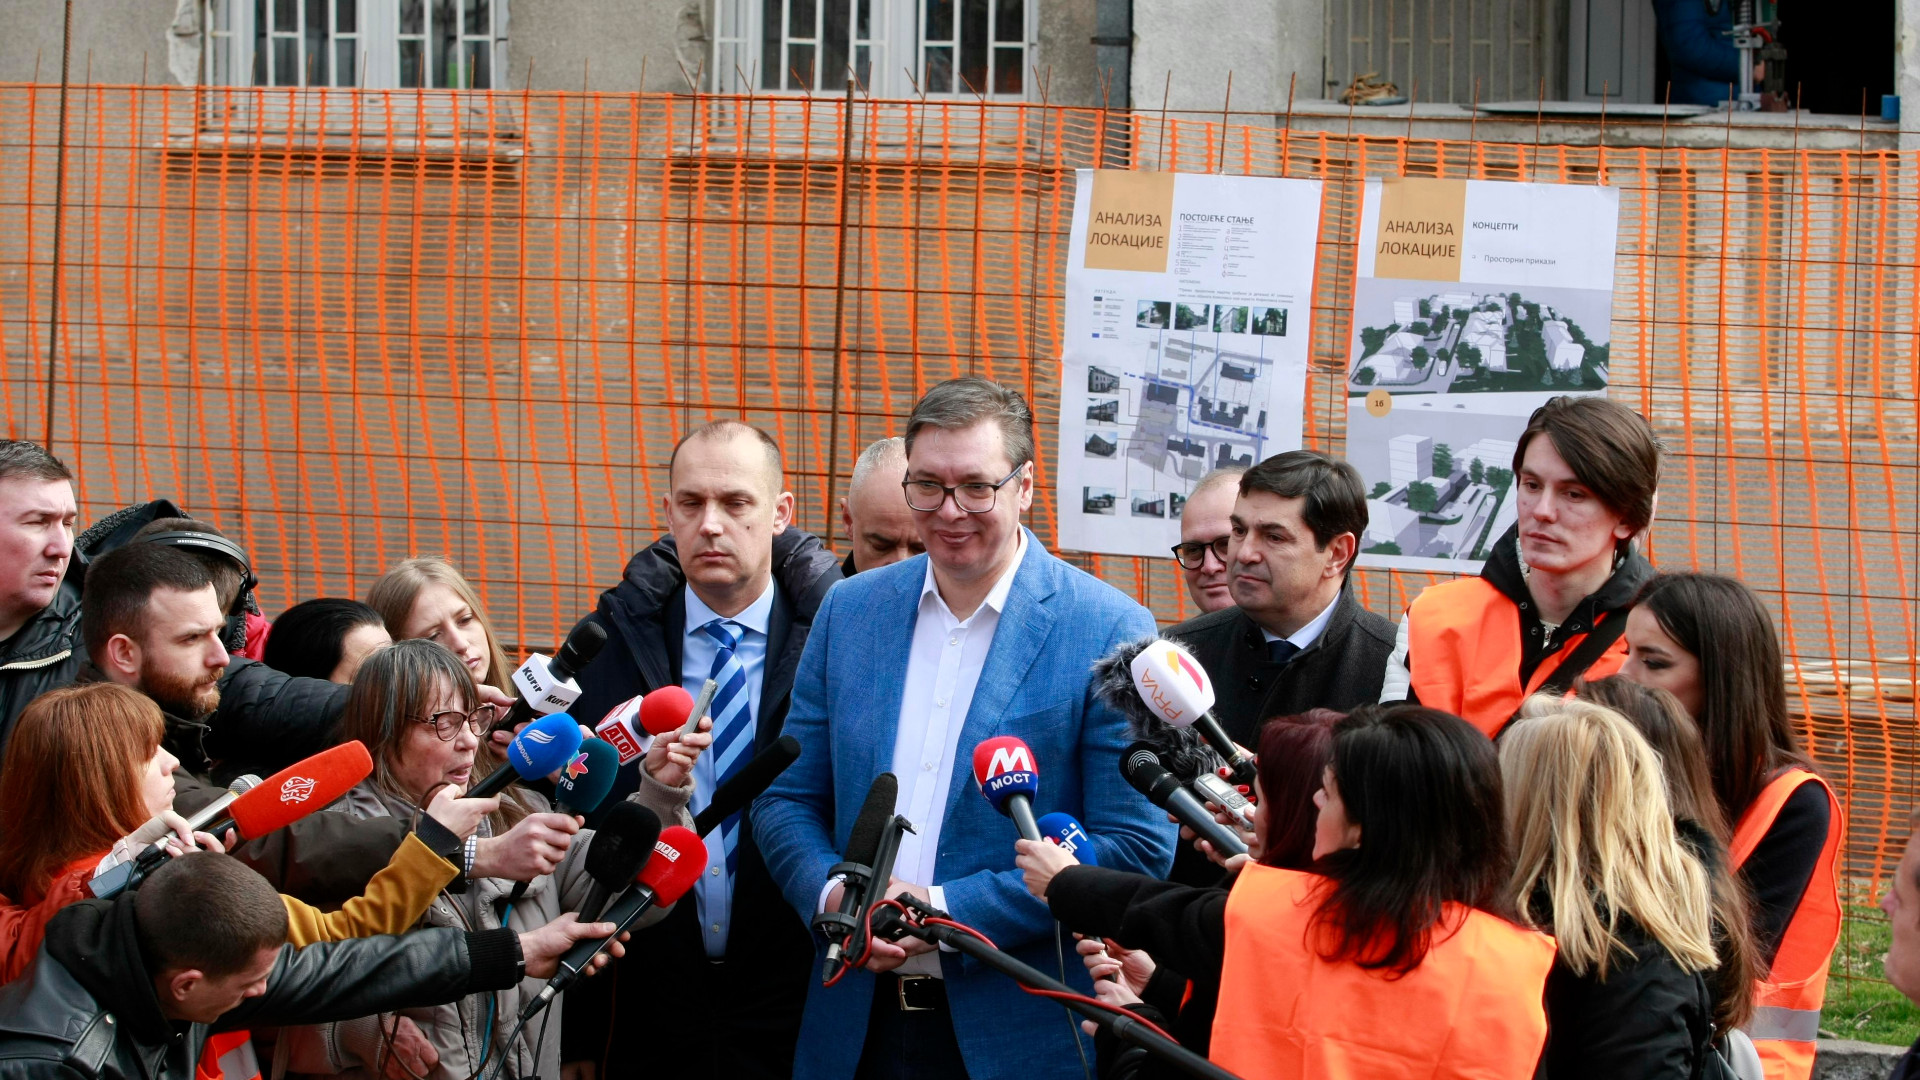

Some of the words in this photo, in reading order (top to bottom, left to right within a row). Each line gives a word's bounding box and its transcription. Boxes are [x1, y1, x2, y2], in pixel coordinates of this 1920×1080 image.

[1094, 211, 1163, 228] АНАЛИЗА
[1179, 213, 1225, 223] ПОСТОЈЕЋЕ
[1226, 215, 1255, 225] СТАЊЕ
[1472, 221, 1519, 231] КОНЦЕПТИ
[1385, 220, 1454, 236] АНАЛИЗА
[1089, 232, 1164, 250] ЛОКАЦИЈЕ
[1379, 241, 1456, 259] ЛОКАЦИЈЕ
[1484, 254, 1524, 265] Просторни
[1525, 257, 1556, 267] прикази
[1375, 399, 1384, 407] 16
[521, 666, 543, 693] Kurir
[545, 694, 570, 708] Kurir
[1141, 667, 1183, 720] PRVA
[605, 726, 636, 759] ALO!
